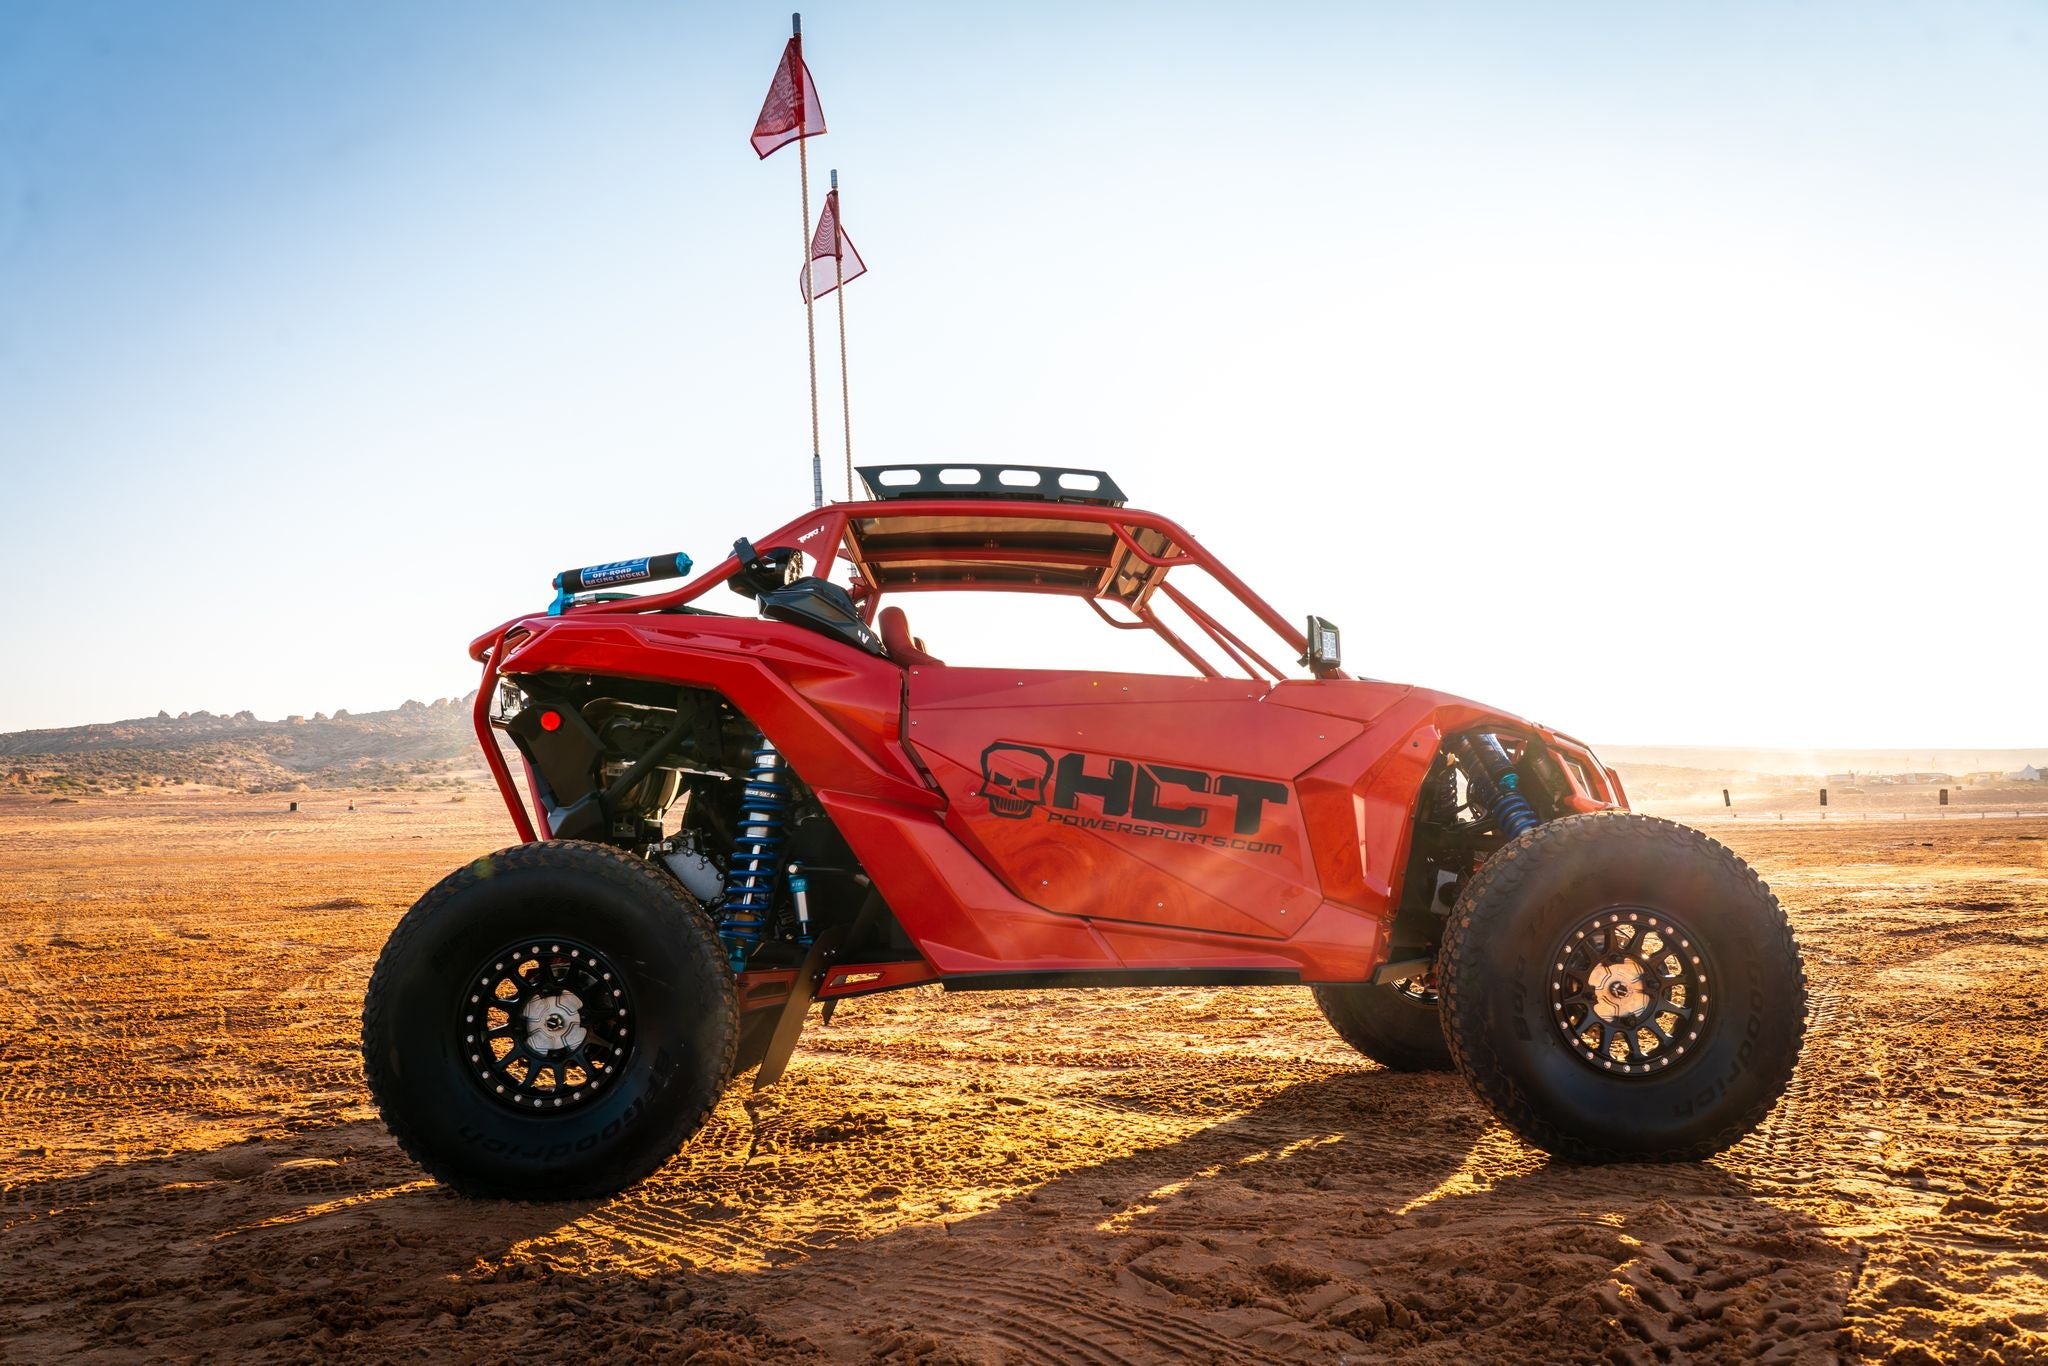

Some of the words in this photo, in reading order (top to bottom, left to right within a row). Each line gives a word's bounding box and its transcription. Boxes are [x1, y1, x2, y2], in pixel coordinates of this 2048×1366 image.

[585, 576, 614, 586] RACING
[615, 571, 646, 580] SHOCKS
[592, 567, 632, 579] OFF-ROAD
[1052, 752, 1289, 836] HCT
